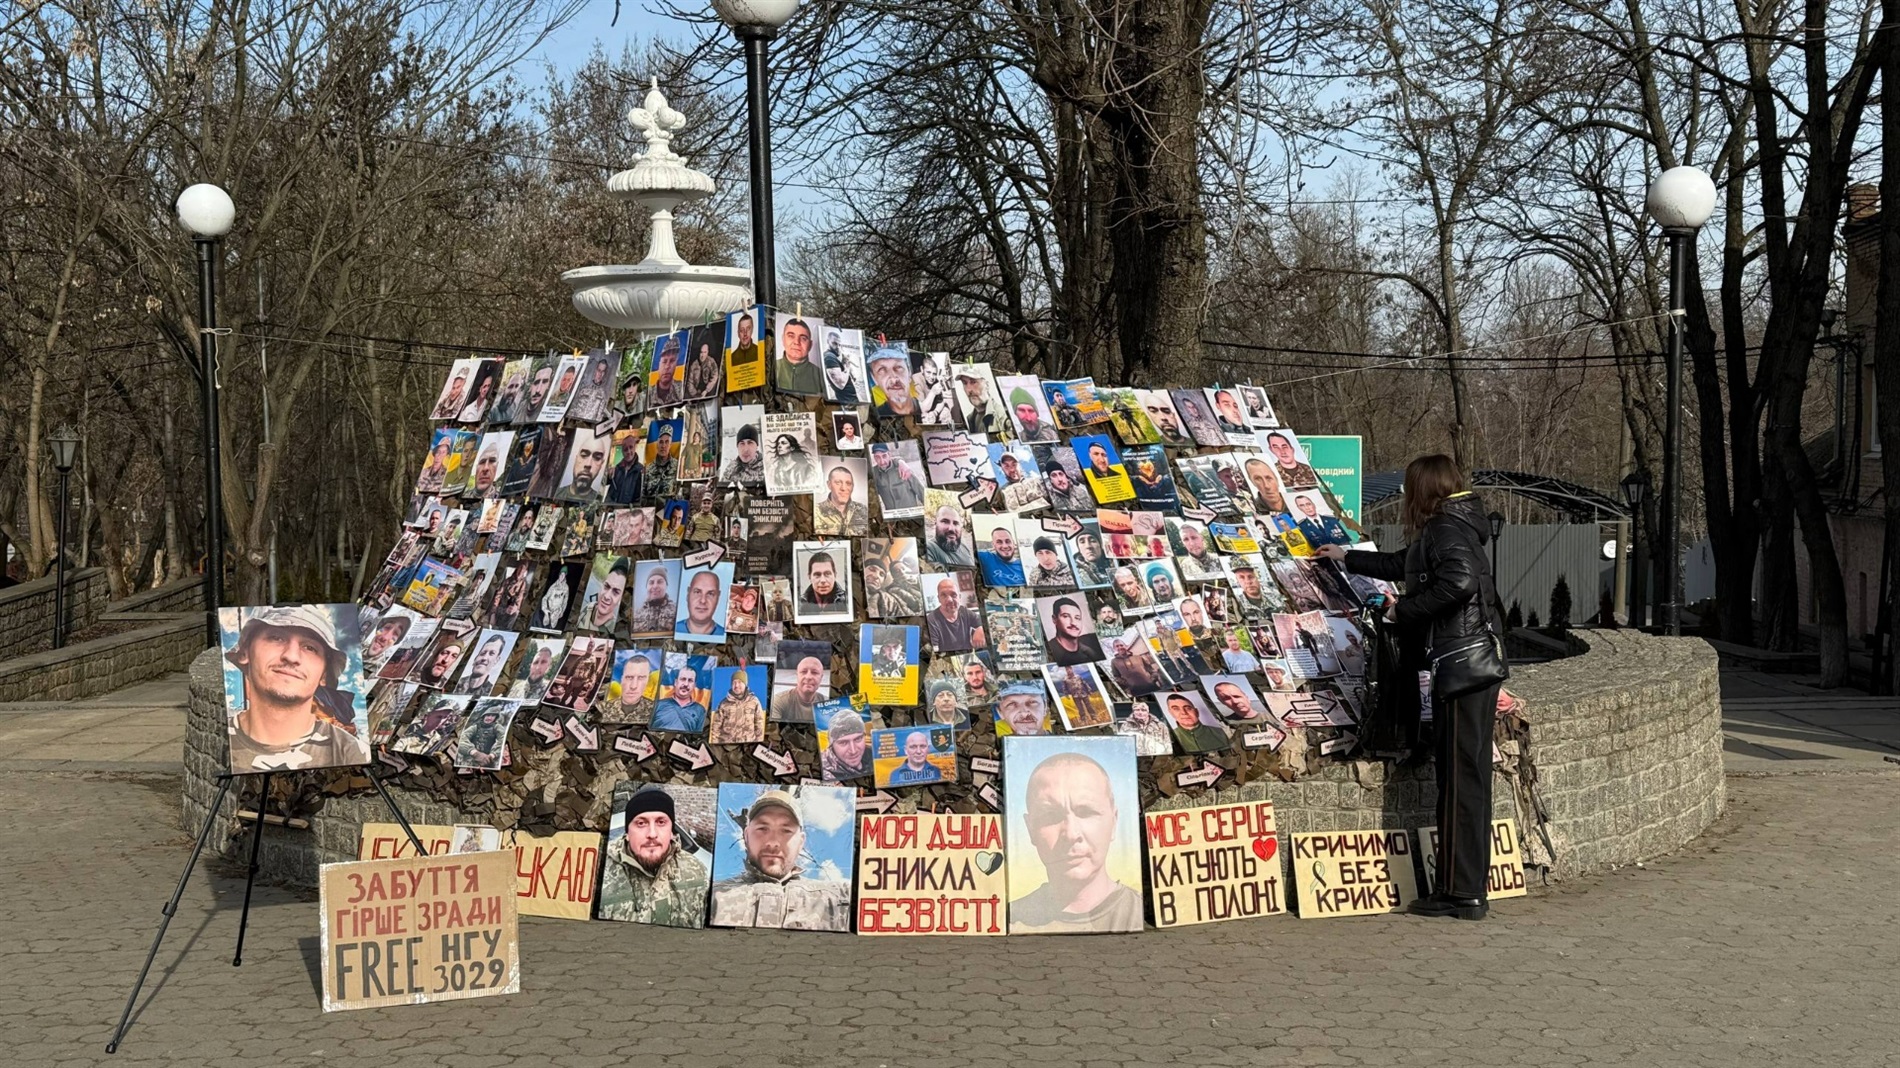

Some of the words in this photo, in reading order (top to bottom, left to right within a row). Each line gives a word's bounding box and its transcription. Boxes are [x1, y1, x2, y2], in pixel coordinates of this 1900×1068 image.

[748, 507, 761, 515] НАМ
[750, 499, 785, 507] ПОВЕРНІТЬ
[753, 515, 783, 523] ЗНИКЛИХ
[862, 816, 918, 849] МОЯ
[926, 816, 1003, 851] ДУША
[1147, 812, 1192, 849] МОЄ
[1201, 802, 1277, 842] СЕРЦЕ
[1294, 832, 1409, 859] КРИЧИМО
[347, 864, 479, 904] ЗАБУТТЯ
[502, 846, 598, 903] УКАЮ
[864, 857, 976, 890] ЗНИКЛА
[1152, 845, 1257, 889] КАТУЮТЬ
[1339, 859, 1391, 884] БЕЗ
[418, 896, 501, 931] ЗРАДИ
[859, 894, 1001, 933] БЕЗВІСТІ
[1159, 891, 1177, 926] В
[1195, 876, 1280, 921] ПОЛОНІ
[1316, 884, 1401, 913] КРИКУ
[441, 929, 502, 962] НГУ
[335, 937, 425, 1000] FREE
[433, 959, 505, 993] 3029
